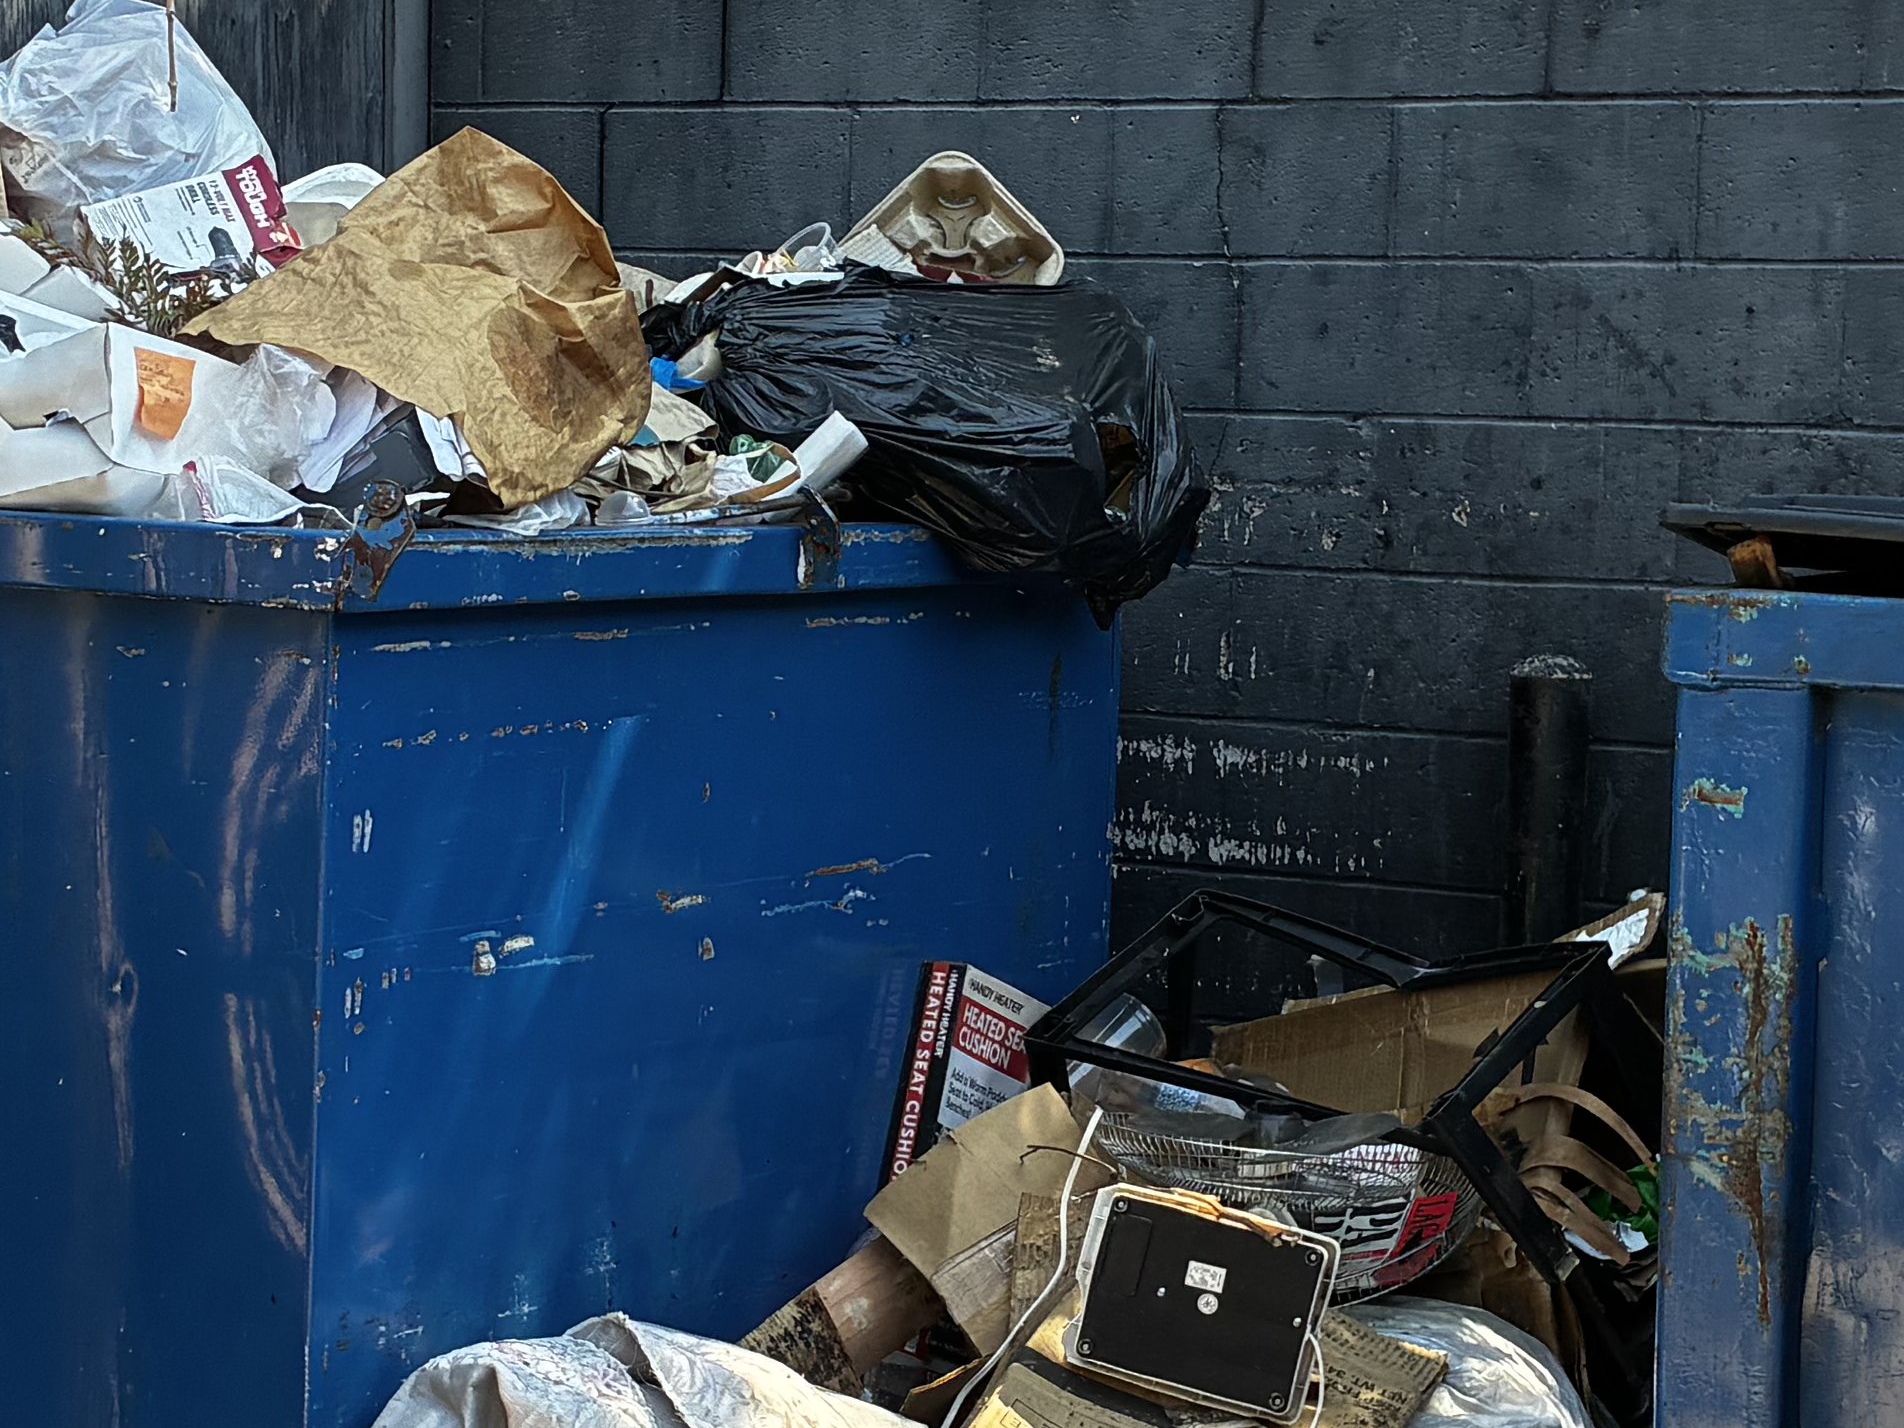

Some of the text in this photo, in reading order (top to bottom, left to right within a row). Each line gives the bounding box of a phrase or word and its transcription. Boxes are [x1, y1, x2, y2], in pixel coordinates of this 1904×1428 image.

[236, 172, 270, 228] TOUGH
[994, 992, 1023, 1015] HEATER
[959, 1027, 1011, 1070] CUSHION
[963, 1005, 1027, 1054] HEATED SEA
[892, 972, 946, 1180] HEATED SEAT CUSHIO
